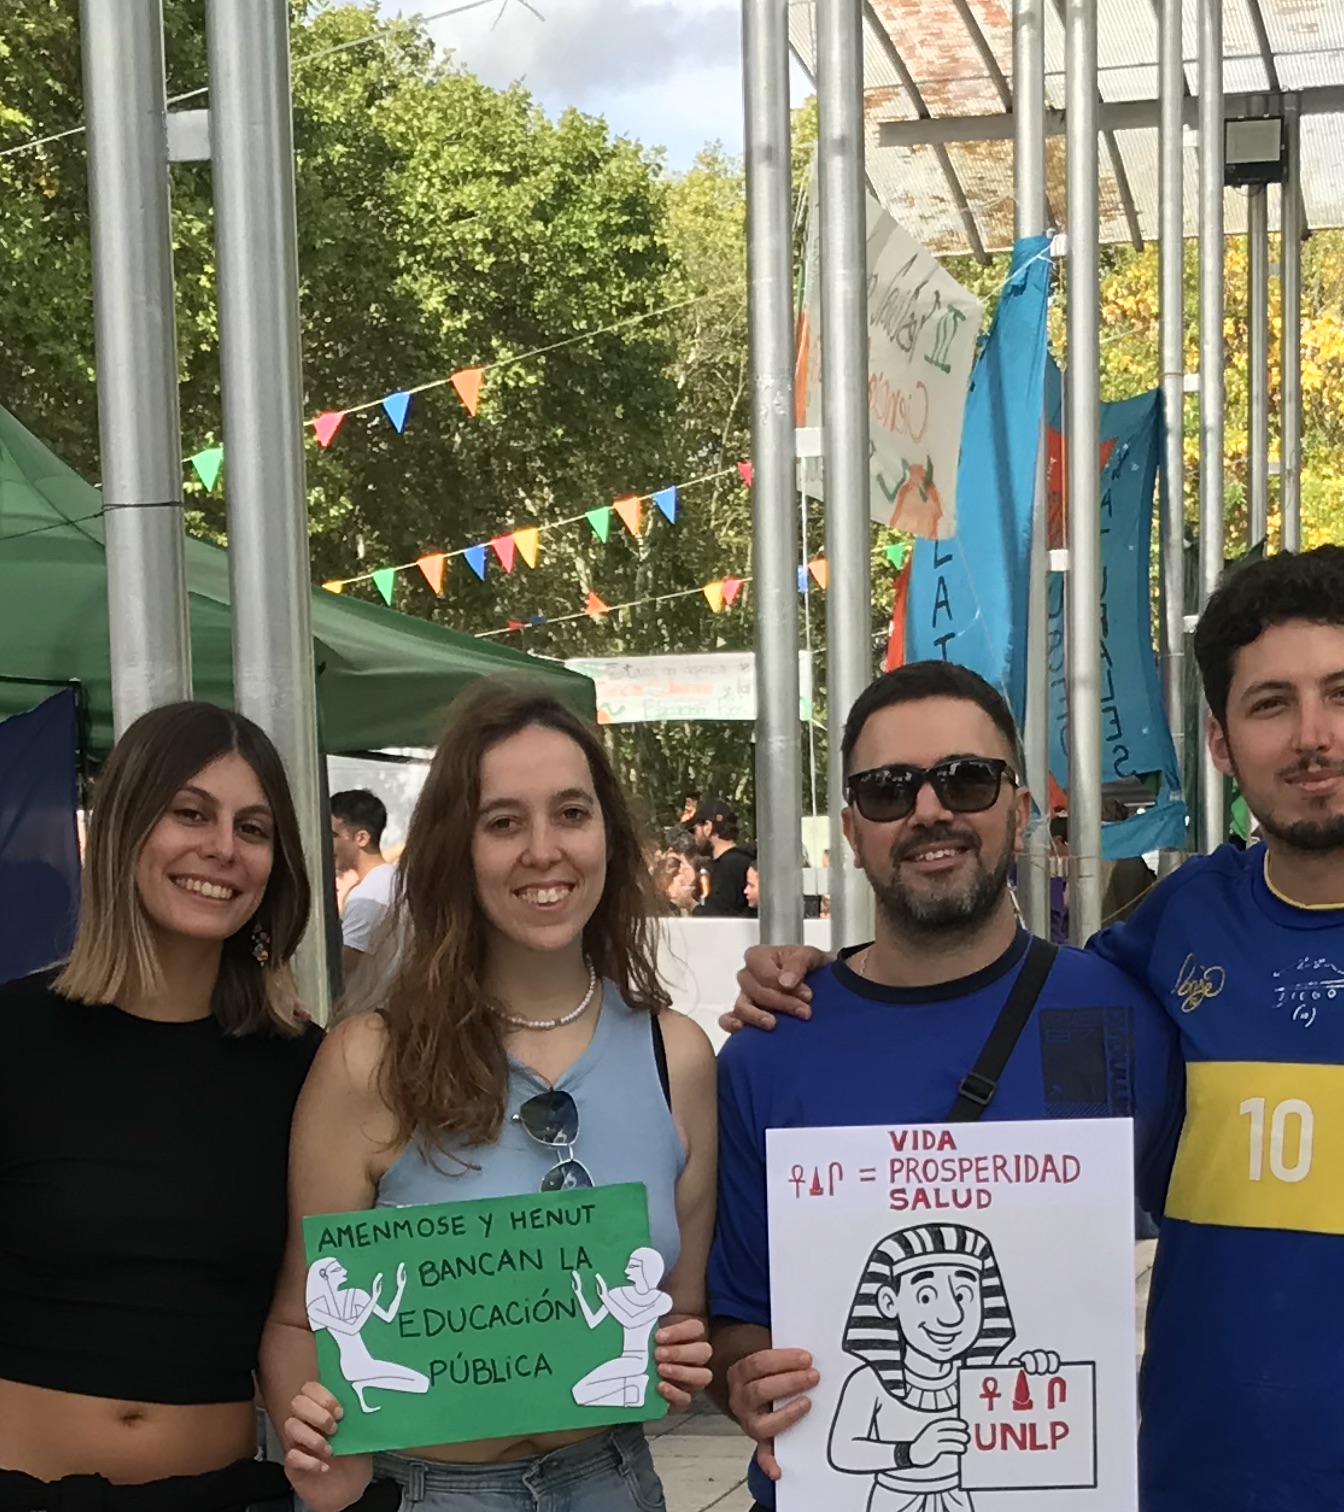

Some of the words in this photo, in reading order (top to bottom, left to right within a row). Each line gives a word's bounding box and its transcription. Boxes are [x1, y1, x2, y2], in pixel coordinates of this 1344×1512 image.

[888, 1129, 957, 1151] VIDA
[1239, 1097, 1314, 1183] 10
[889, 1154, 1081, 1184] PROSPERIDAD
[889, 1187, 992, 1211] SALUD
[318, 1215, 467, 1252] AMENMOSE
[478, 1213, 493, 1238] Y
[510, 1204, 596, 1230] HENUT
[418, 1248, 543, 1287] BANCAN
[560, 1246, 593, 1271] LA
[974, 1422, 1070, 1451] UNLP
